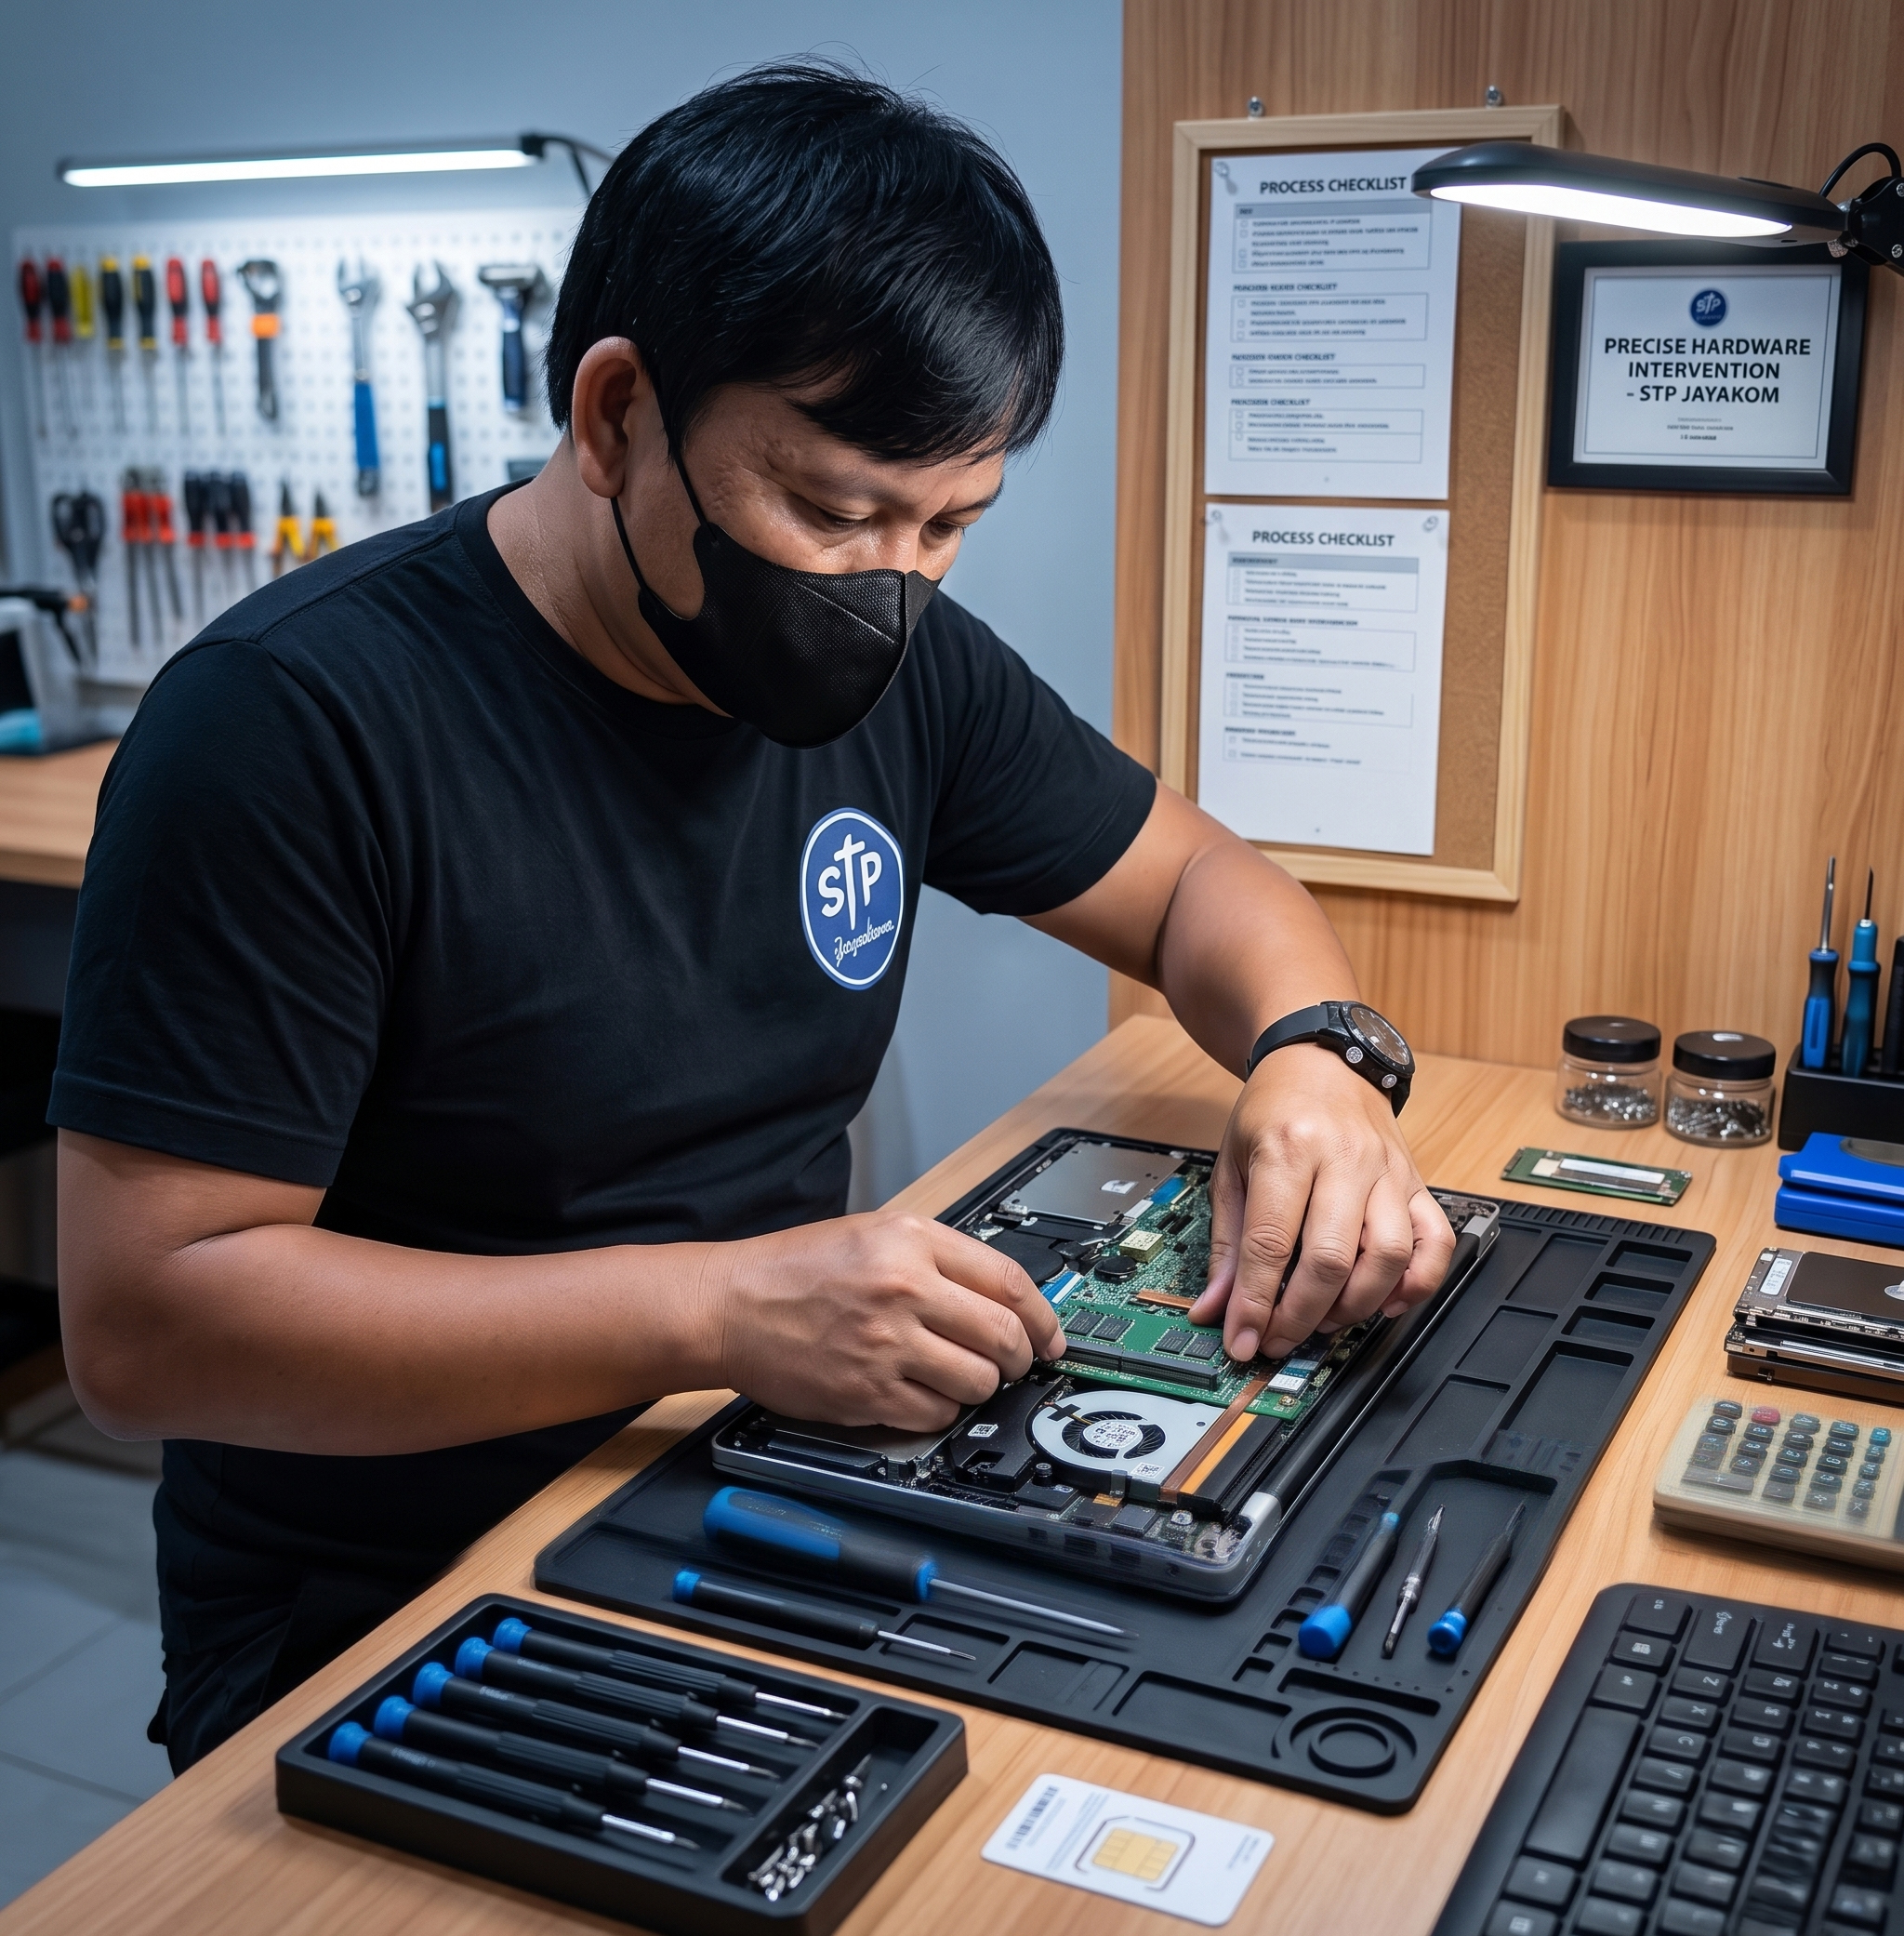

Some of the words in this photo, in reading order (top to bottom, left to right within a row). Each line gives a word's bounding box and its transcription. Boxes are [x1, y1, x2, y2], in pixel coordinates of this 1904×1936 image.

[1261, 179, 1324, 193] PROCESS
[1329, 177, 1407, 192] CHECKLIST
[1696, 292, 1722, 314] STP
[1605, 338, 1686, 354] PRECISE
[1692, 338, 1810, 355] HARDWARE
[1629, 362, 1779, 378] INTERVENTION
[1640, 385, 1676, 401] STP
[1682, 386, 1778, 403] JAYAKOM
[1252, 531, 1314, 544] PROCESS
[1318, 533, 1395, 547] CHECKLIST
[818, 833, 882, 931] STP
